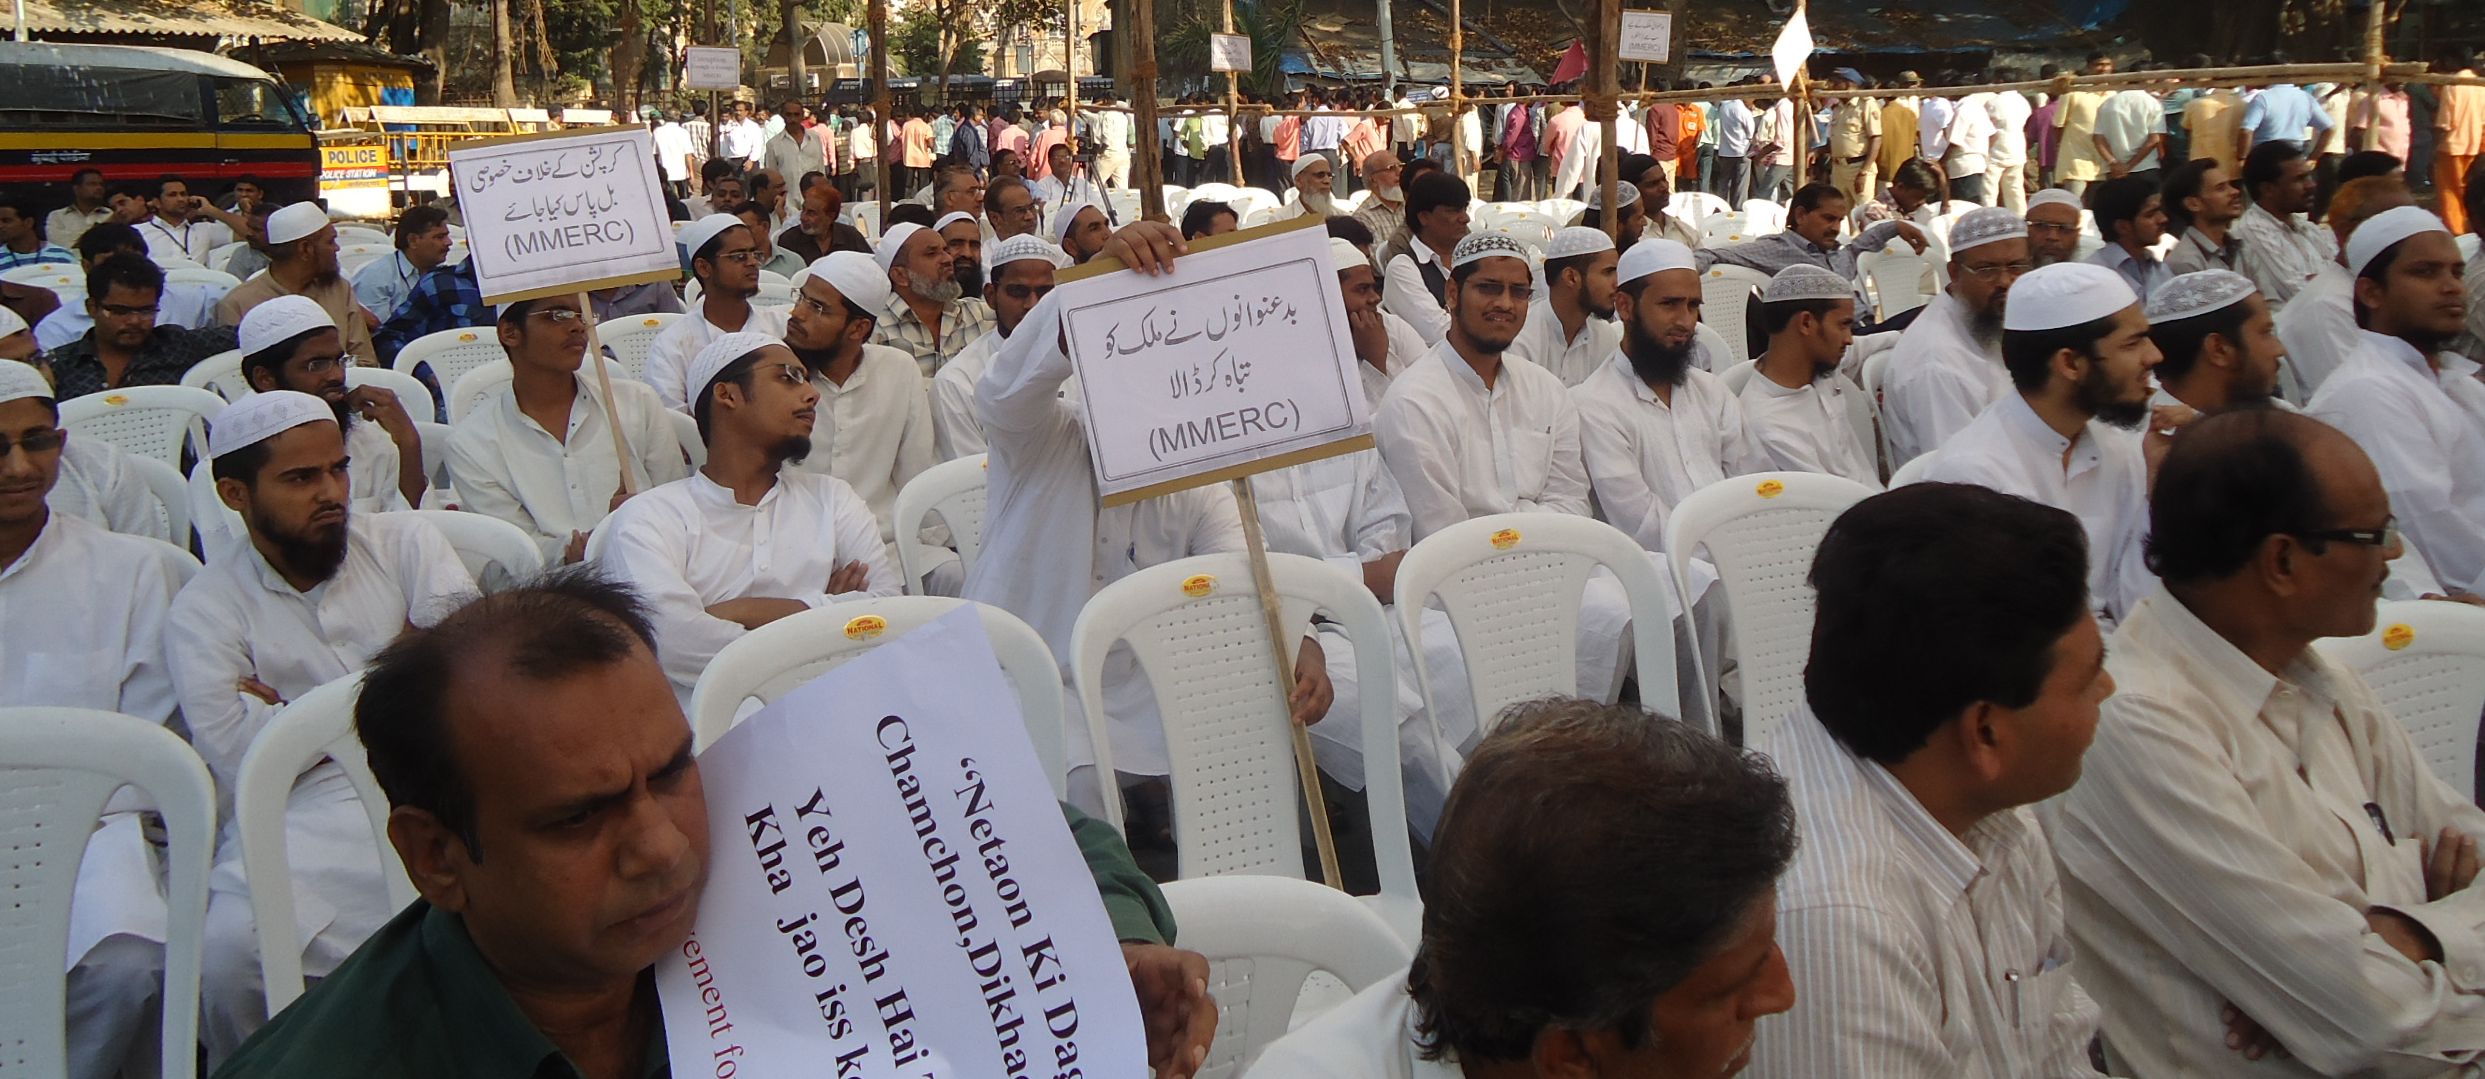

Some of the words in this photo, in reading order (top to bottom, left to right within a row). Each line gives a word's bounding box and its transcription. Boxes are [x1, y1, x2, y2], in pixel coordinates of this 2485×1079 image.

[320, 170, 346, 181] POLICE
[345, 168, 377, 179] STATION
[328, 149, 377, 164] POLICE
[512, 160, 552, 184] خلاف
[552, 152, 579, 178] کے
[580, 145, 624, 178] کرپشن
[470, 159, 512, 193] خصوصی
[564, 190, 597, 218] پاس
[598, 184, 618, 212] بل
[504, 219, 634, 262] (MMERC)
[1104, 322, 1120, 359] کو
[1118, 306, 1162, 355] ملک
[1164, 310, 1202, 346] نے
[1225, 355, 1251, 393] تباہ
[1149, 398, 1301, 462] (MMERC)
[847, 621, 884, 635] NATIONAL
[953, 757, 1033, 930] “Netaon
[1020, 933, 1066, 994] Ki
[876, 715, 1029, 1079] Chamchon,Dikha
[744, 802, 793, 896] Kha
[776, 912, 827, 978] jao
[815, 983, 854, 1040] iss
[835, 1044, 869, 1079] k
[794, 785, 846, 875] Yeh
[828, 875, 890, 984] Desh
[874, 986, 930, 1069] Hai
[683, 930, 734, 1040] ement
[714, 1043, 744, 1079] fo
